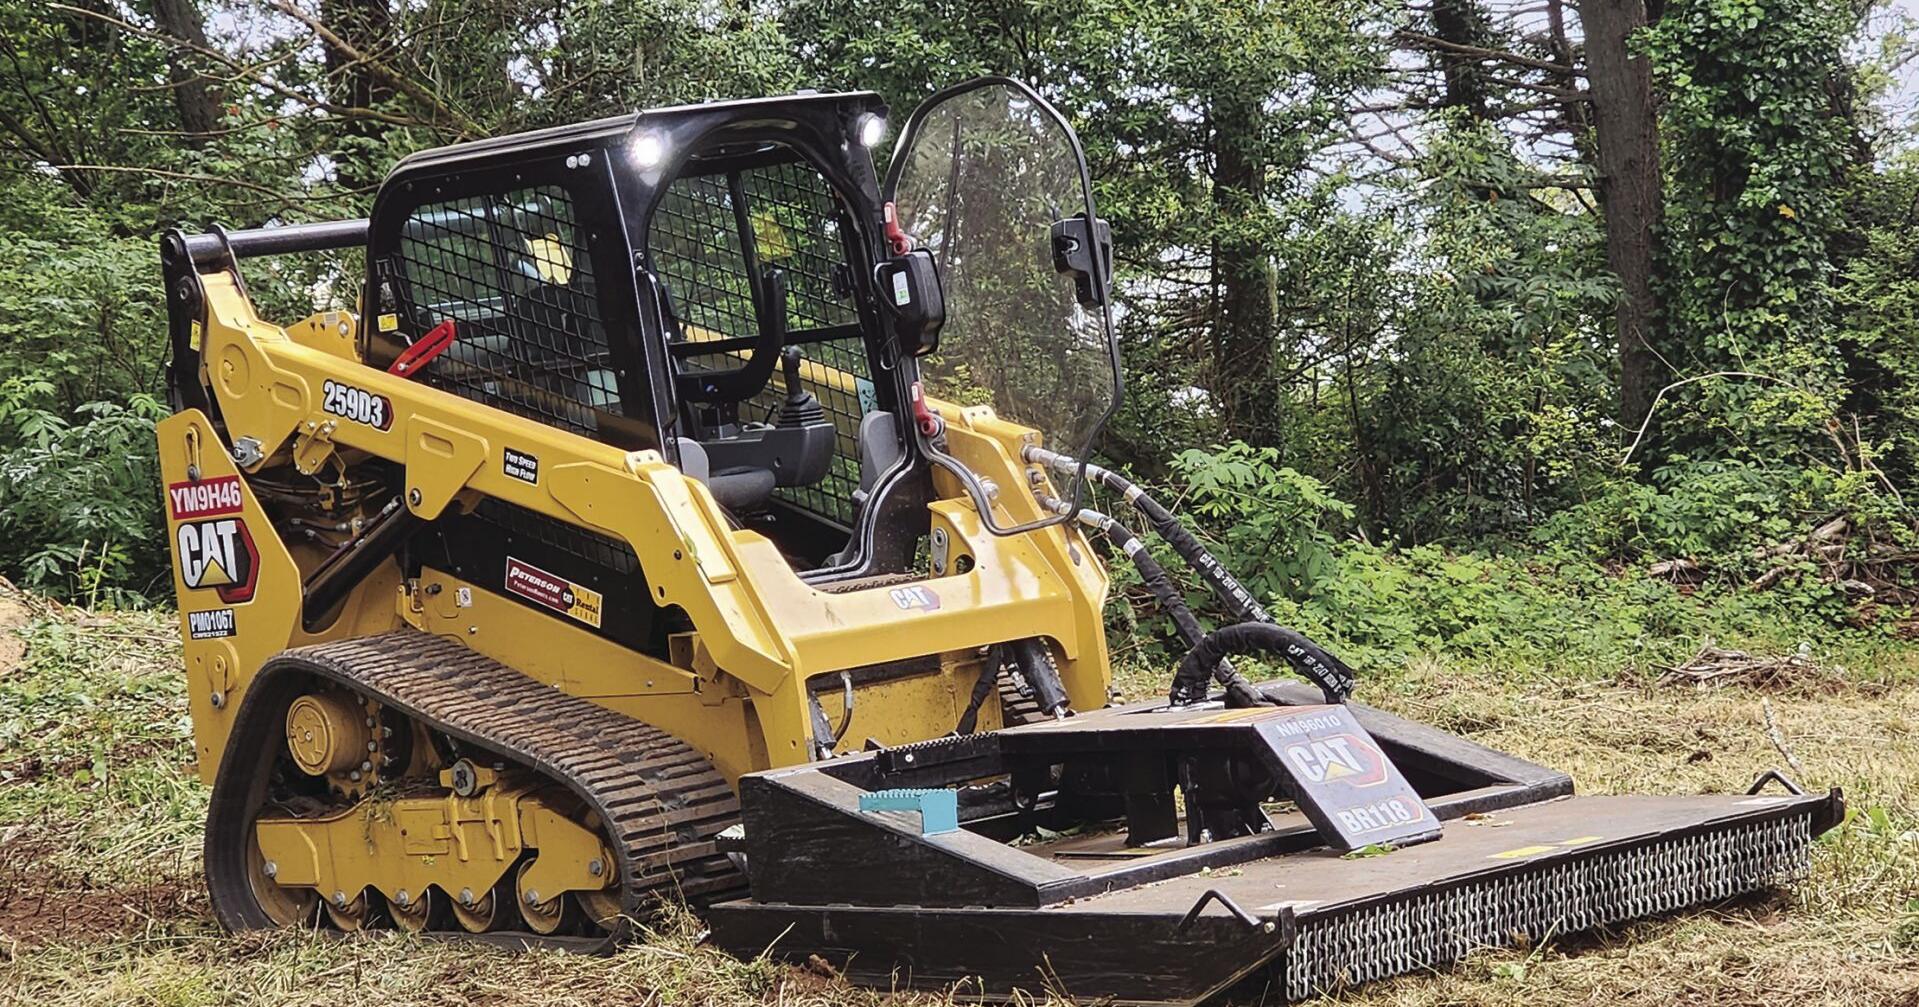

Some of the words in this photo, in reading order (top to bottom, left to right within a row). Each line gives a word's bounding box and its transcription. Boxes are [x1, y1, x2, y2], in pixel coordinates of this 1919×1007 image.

[324, 381, 383, 428] 259D3
[171, 481, 241, 514] YM9H46
[178, 520, 237, 588] CAT
[576, 597, 598, 614] Rental
[890, 586, 930, 609] CAT
[190, 610, 233, 632] PM01067
[1276, 715, 1341, 737] NM96010
[1287, 737, 1364, 783] CAT
[1337, 799, 1410, 833] BR118
